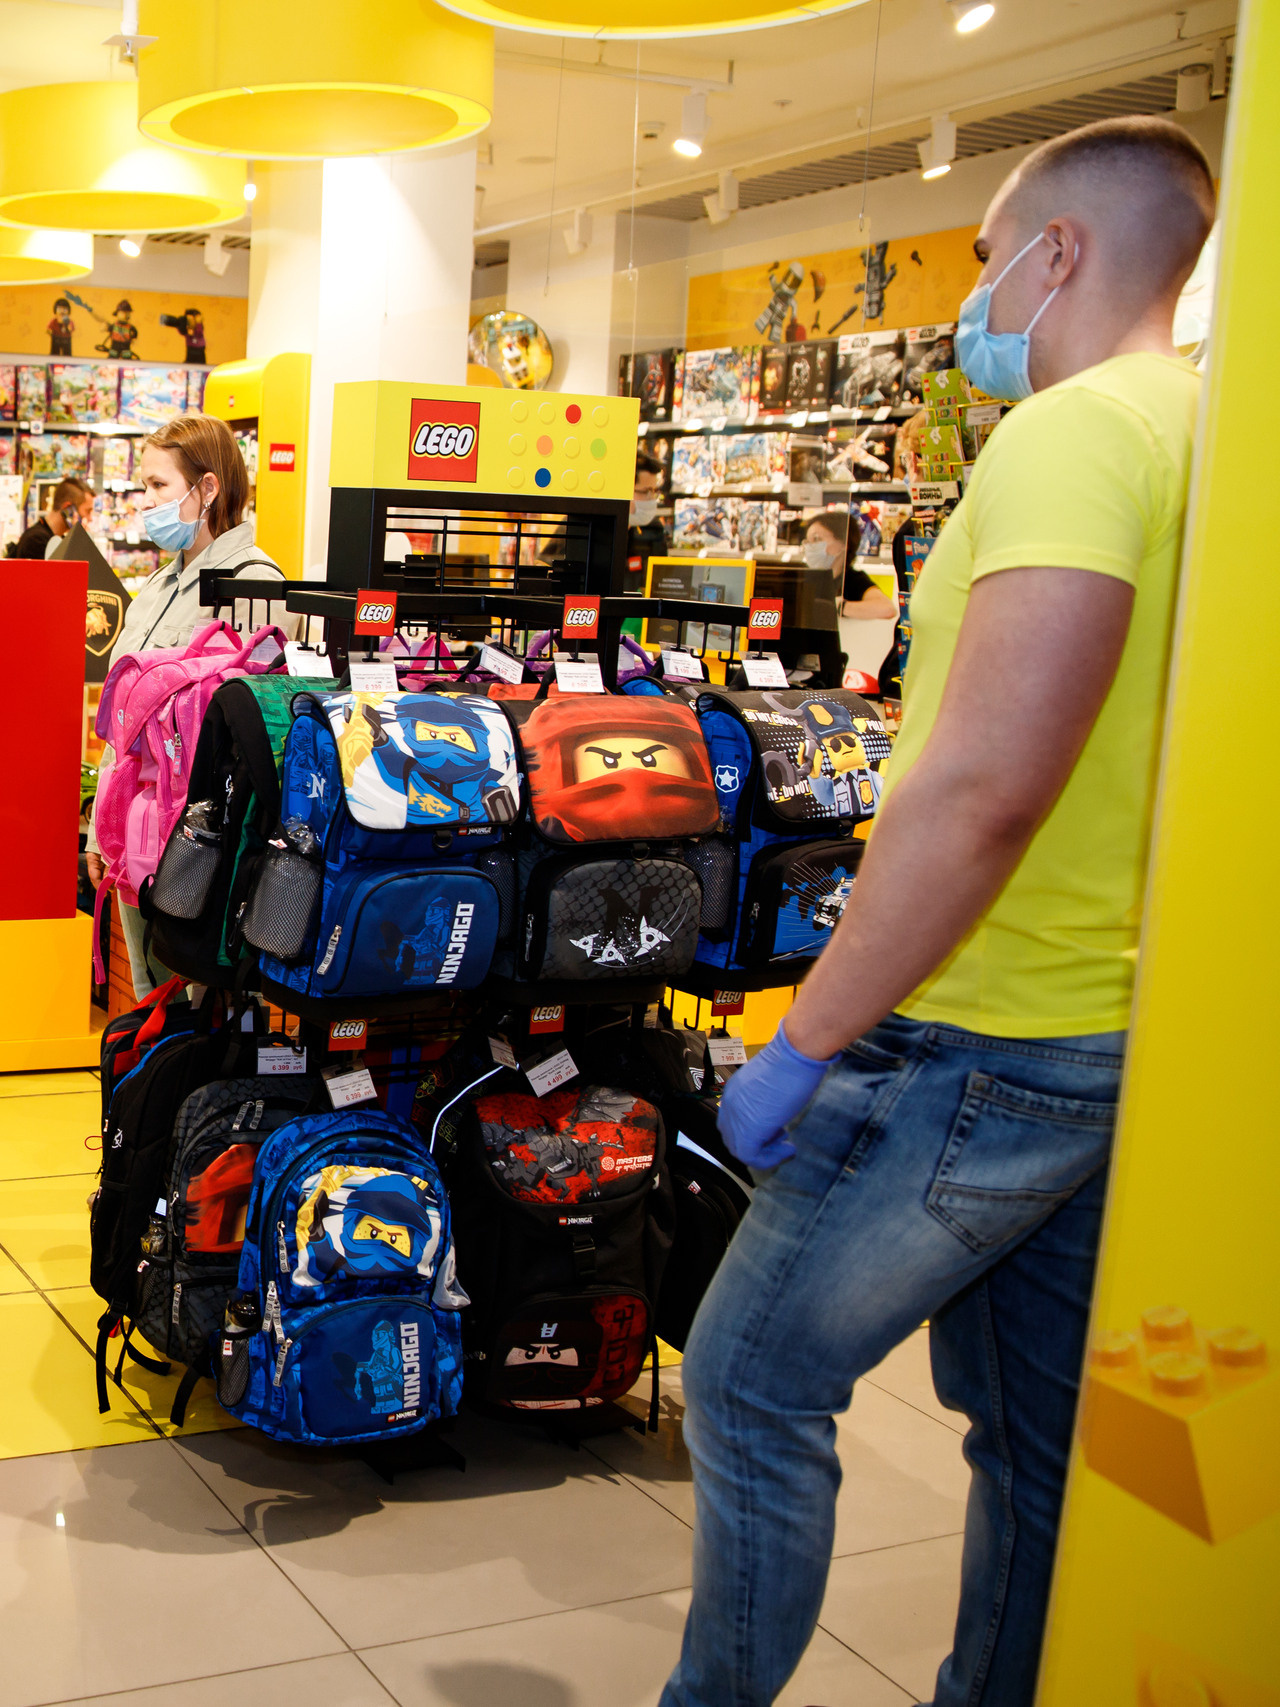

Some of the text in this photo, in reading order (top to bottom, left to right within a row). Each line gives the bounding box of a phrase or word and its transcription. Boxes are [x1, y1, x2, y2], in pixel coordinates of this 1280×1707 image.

[412, 422, 476, 458] LEGO
[271, 450, 294, 464] LEGO
[357, 603, 394, 623] LEGO
[565, 608, 598, 627] LEGO
[750, 610, 781, 628] LEGO
[435, 903, 475, 984] NINJAGO
[532, 1004, 564, 1022] LEGO
[331, 1019, 367, 1039] LEGO
[616, 1155, 653, 1166] MASTERS
[400, 1322, 421, 1408] NINJAGO
